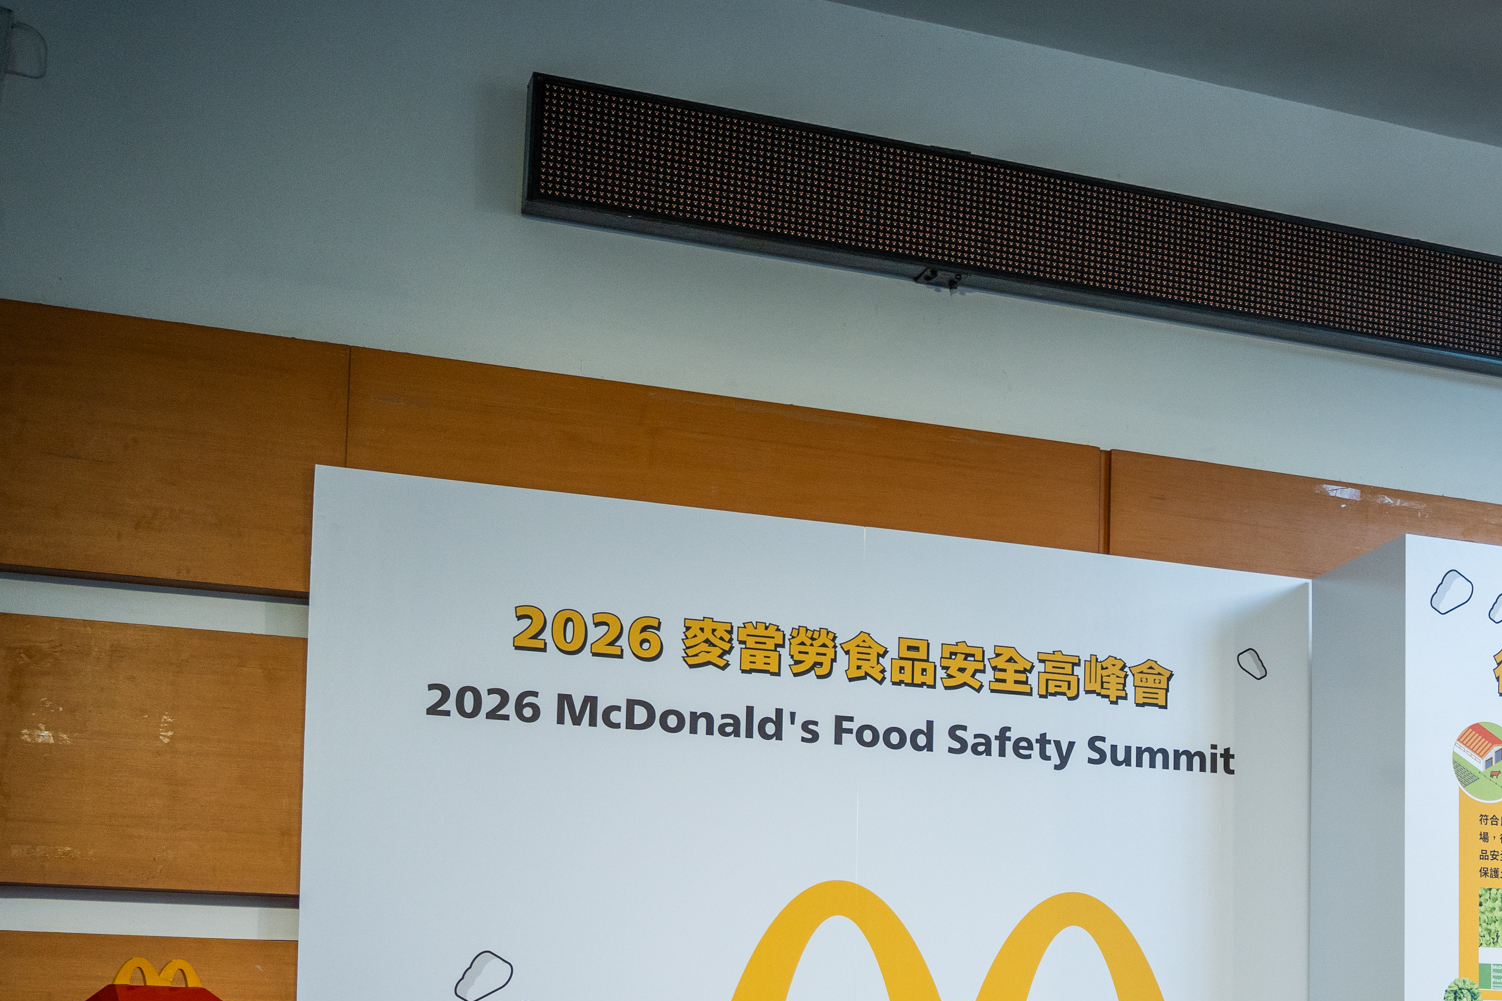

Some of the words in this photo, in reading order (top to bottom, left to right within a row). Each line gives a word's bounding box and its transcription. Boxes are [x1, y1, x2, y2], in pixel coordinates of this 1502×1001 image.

[513, 605, 662, 662] 2026
[682, 616, 1173, 709] 麥當勞食品安全高峰會
[426, 683, 541, 723] 2026
[556, 693, 820, 744] McDonald's
[834, 715, 934, 752] Food
[948, 724, 1076, 770] Safety
[1087, 735, 1235, 775] Summit
